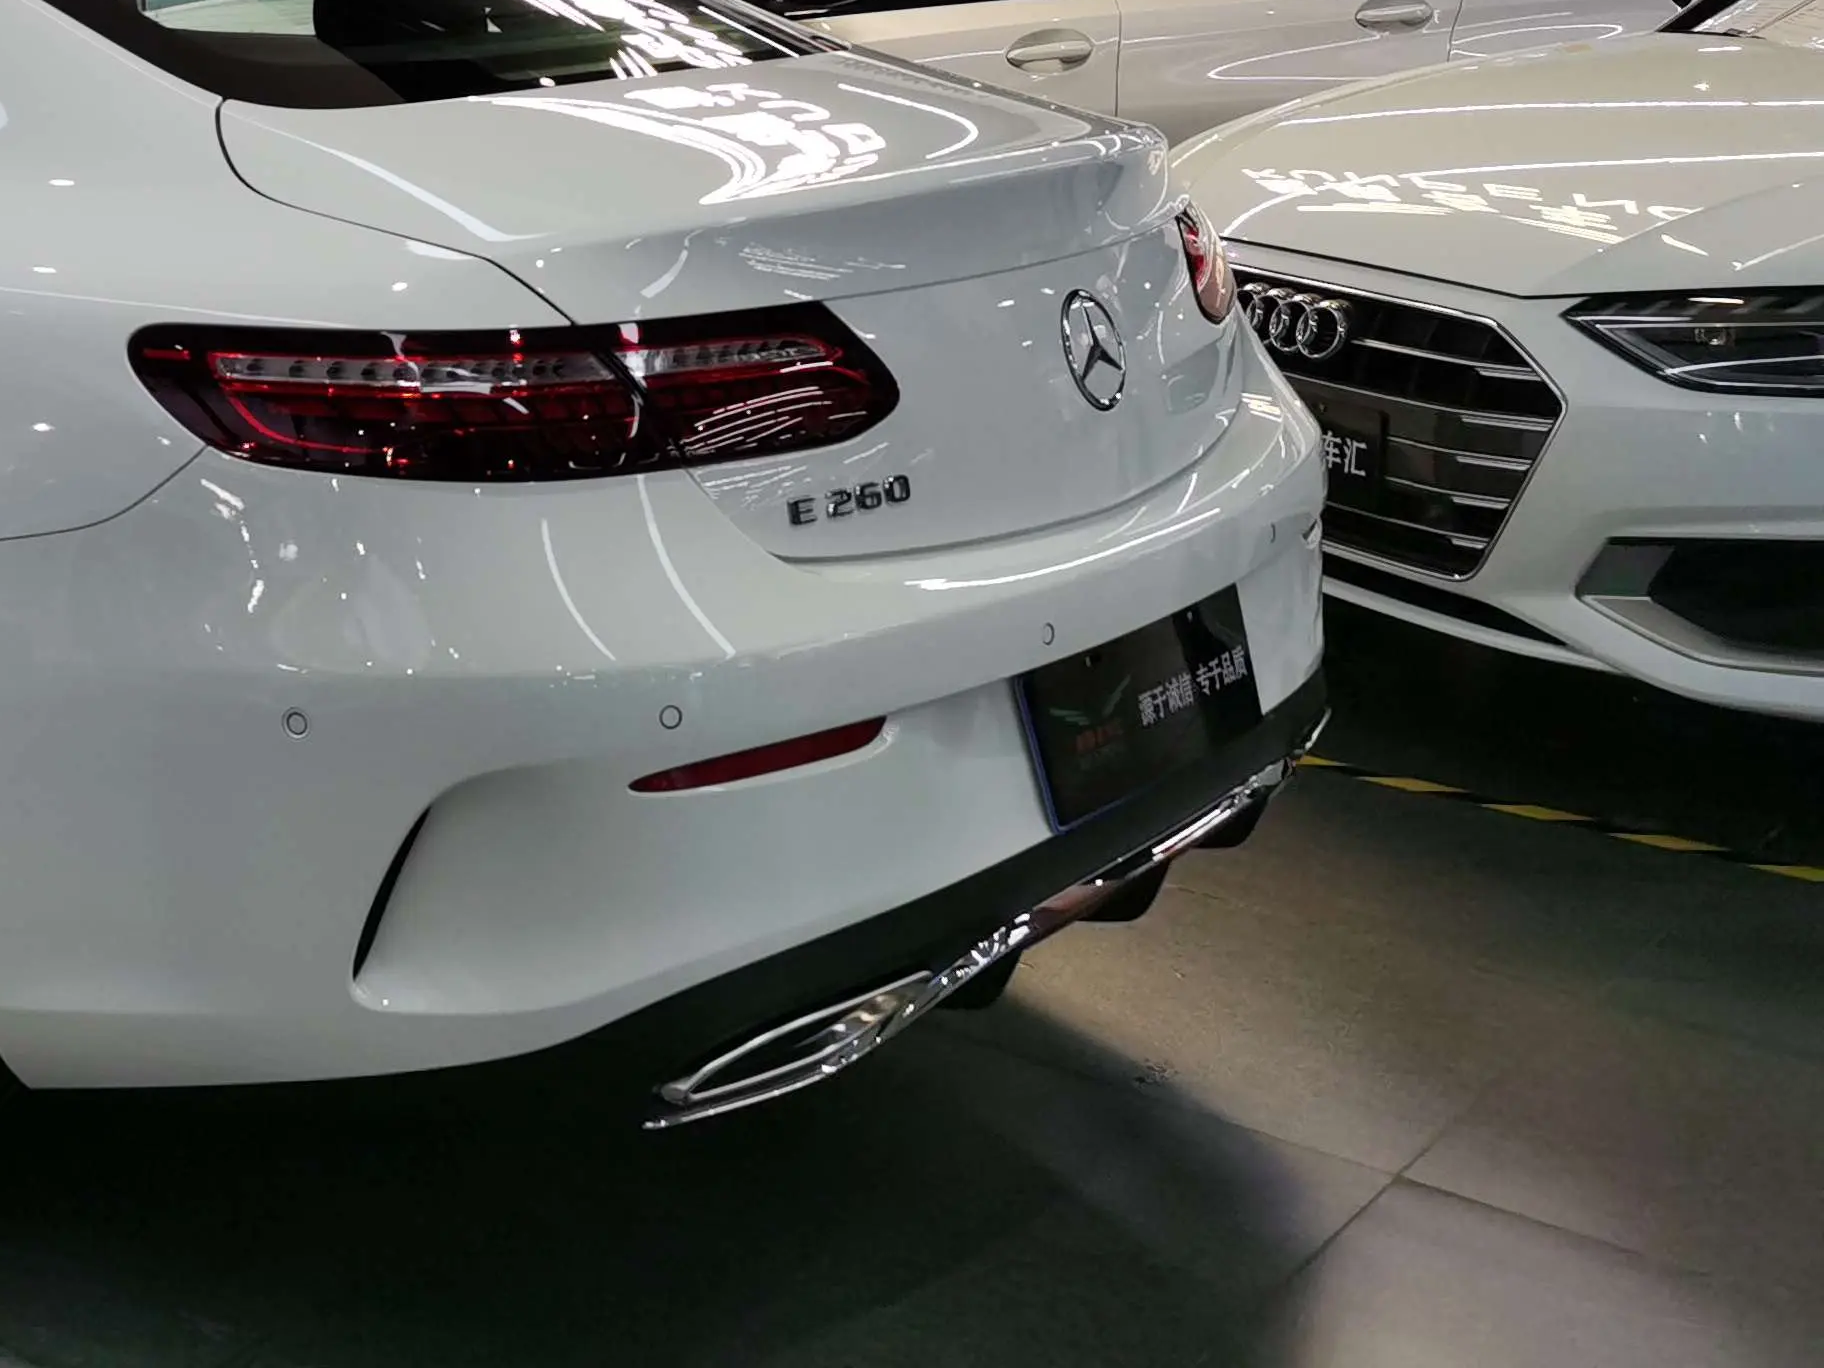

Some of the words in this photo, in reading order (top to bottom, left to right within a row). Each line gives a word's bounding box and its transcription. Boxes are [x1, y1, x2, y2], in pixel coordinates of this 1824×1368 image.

[787, 495, 818, 526] E
[825, 474, 911, 518] 260
[1195, 644, 1249, 697] 专于品质
